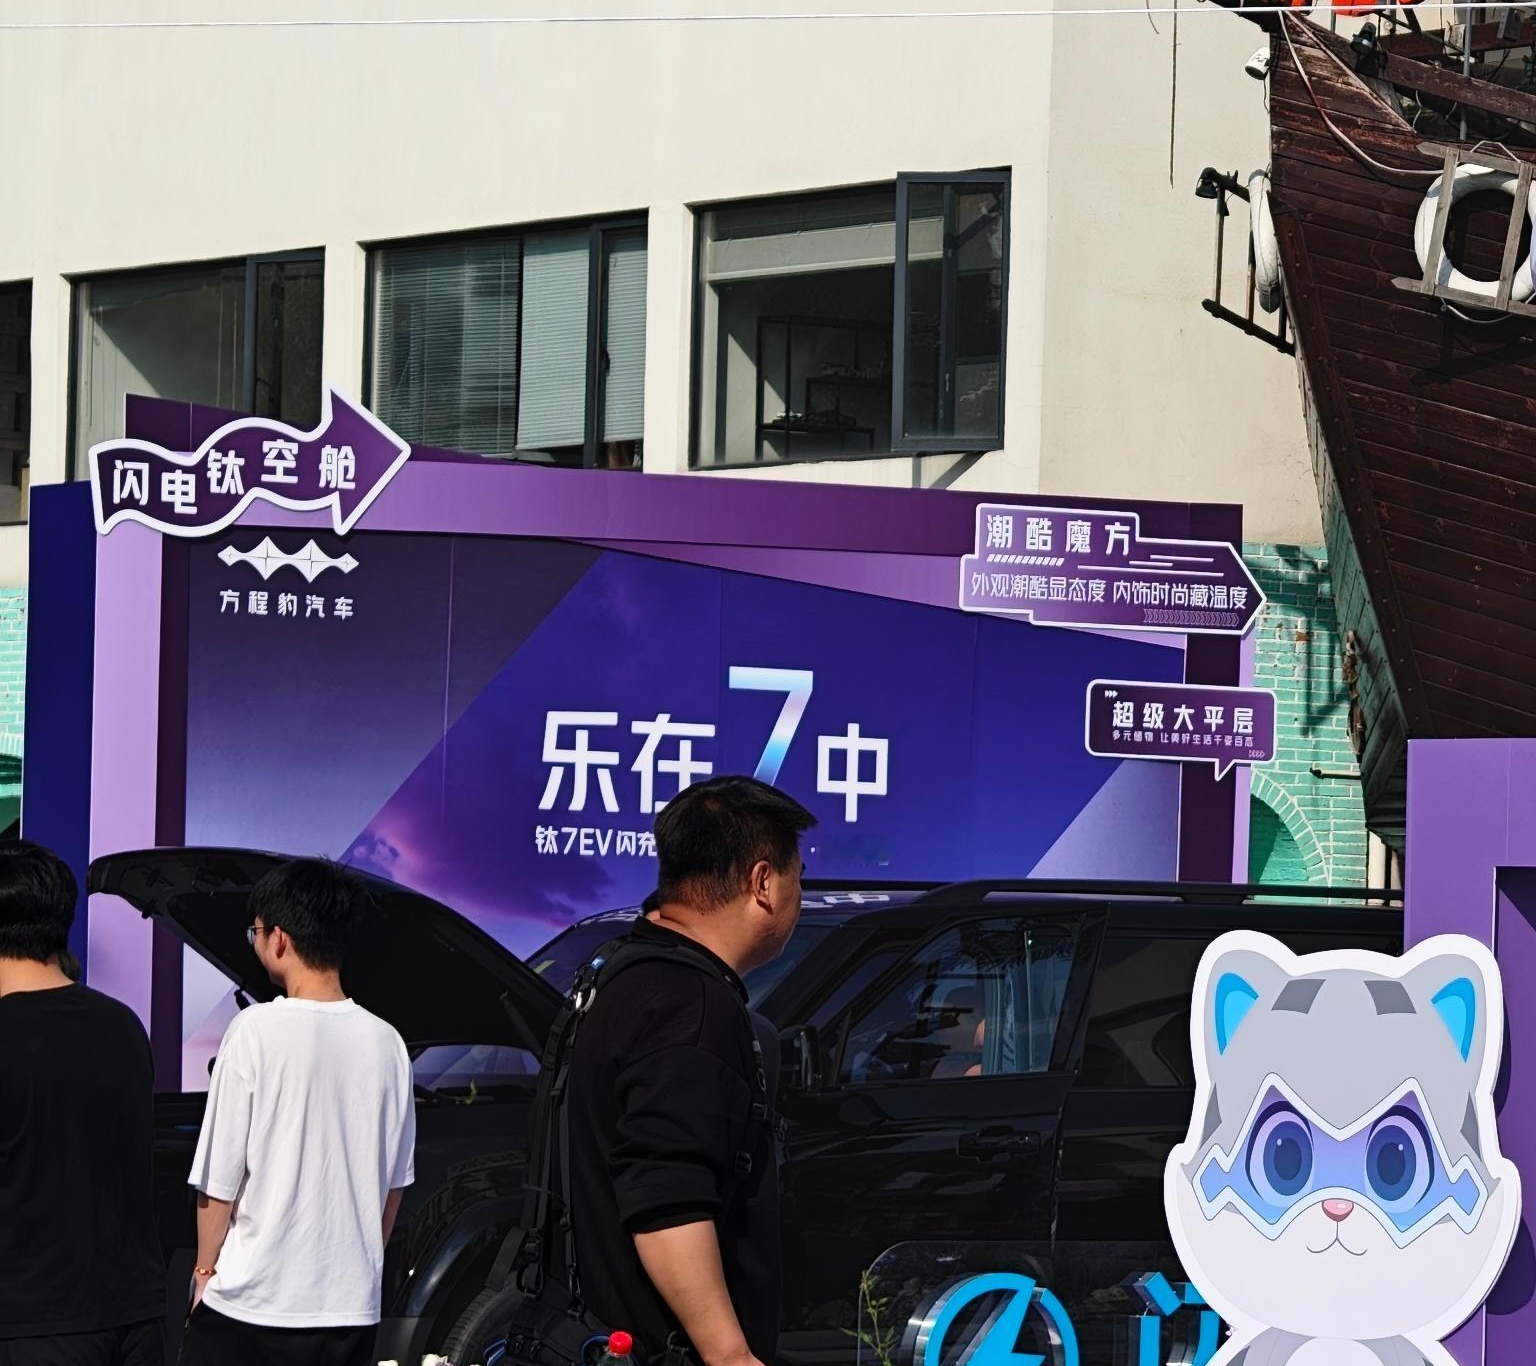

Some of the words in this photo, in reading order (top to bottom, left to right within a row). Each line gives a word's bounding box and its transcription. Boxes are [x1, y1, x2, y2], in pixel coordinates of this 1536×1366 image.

[111, 439, 357, 515] 闪电钛空舱
[986, 514, 1131, 556] 潮酷魔方
[219, 588, 355, 620] 方程豹汽车
[971, 571, 1107, 603] 外观潮酷显态度
[1112, 579, 1249, 611] 内饰时尚藏温度
[1112, 699, 1254, 734] 超级大平层
[537, 665, 889, 823] 乐在7中
